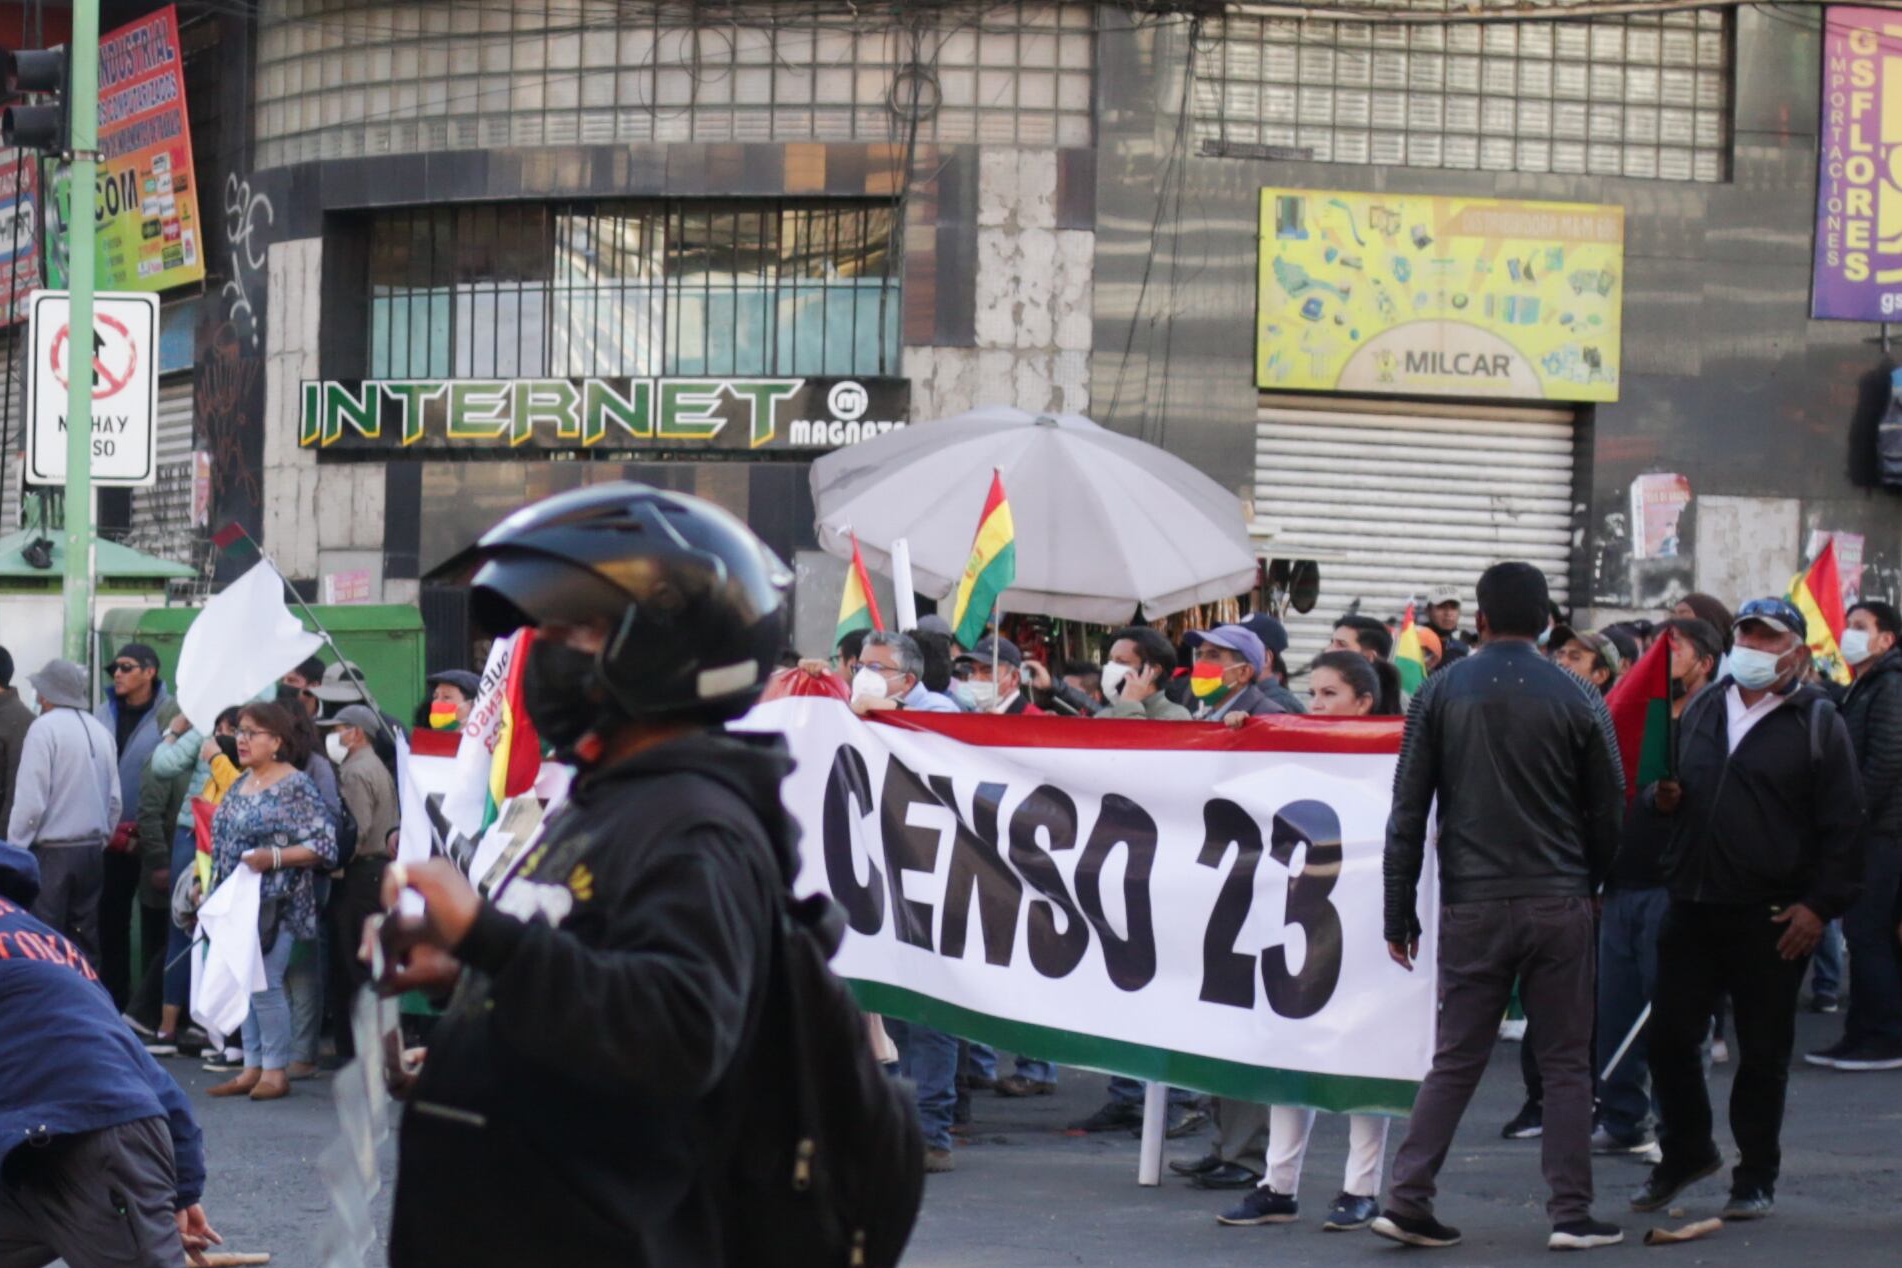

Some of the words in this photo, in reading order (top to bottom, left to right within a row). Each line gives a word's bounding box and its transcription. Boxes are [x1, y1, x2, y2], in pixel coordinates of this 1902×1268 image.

[97, 17, 174, 90] NDUSTRIAL
[1827, 40, 1846, 267] IMPORTACIONES
[1844, 27, 1878, 282] GSFLORES
[300, 380, 806, 448] INTERNET
[1405, 351, 1511, 377] MILCAR
[823, 743, 1158, 991] CENSO
[1196, 798, 1343, 1019] 23
